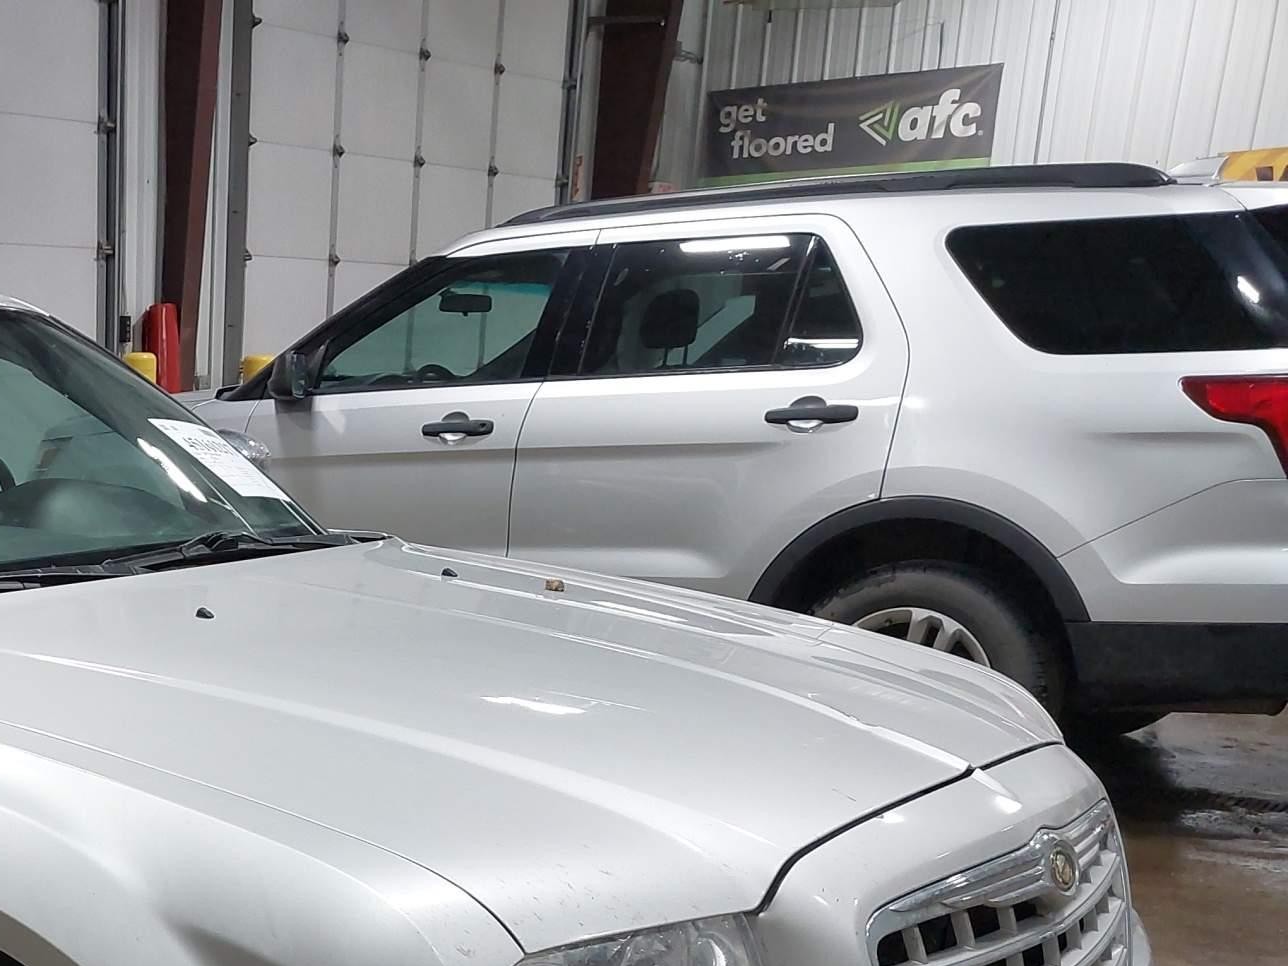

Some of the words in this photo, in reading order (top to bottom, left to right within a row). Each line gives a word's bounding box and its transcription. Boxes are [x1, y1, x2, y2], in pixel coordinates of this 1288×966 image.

[719, 98, 767, 133] get
[898, 88, 982, 142] afc
[731, 122, 835, 159] floored
